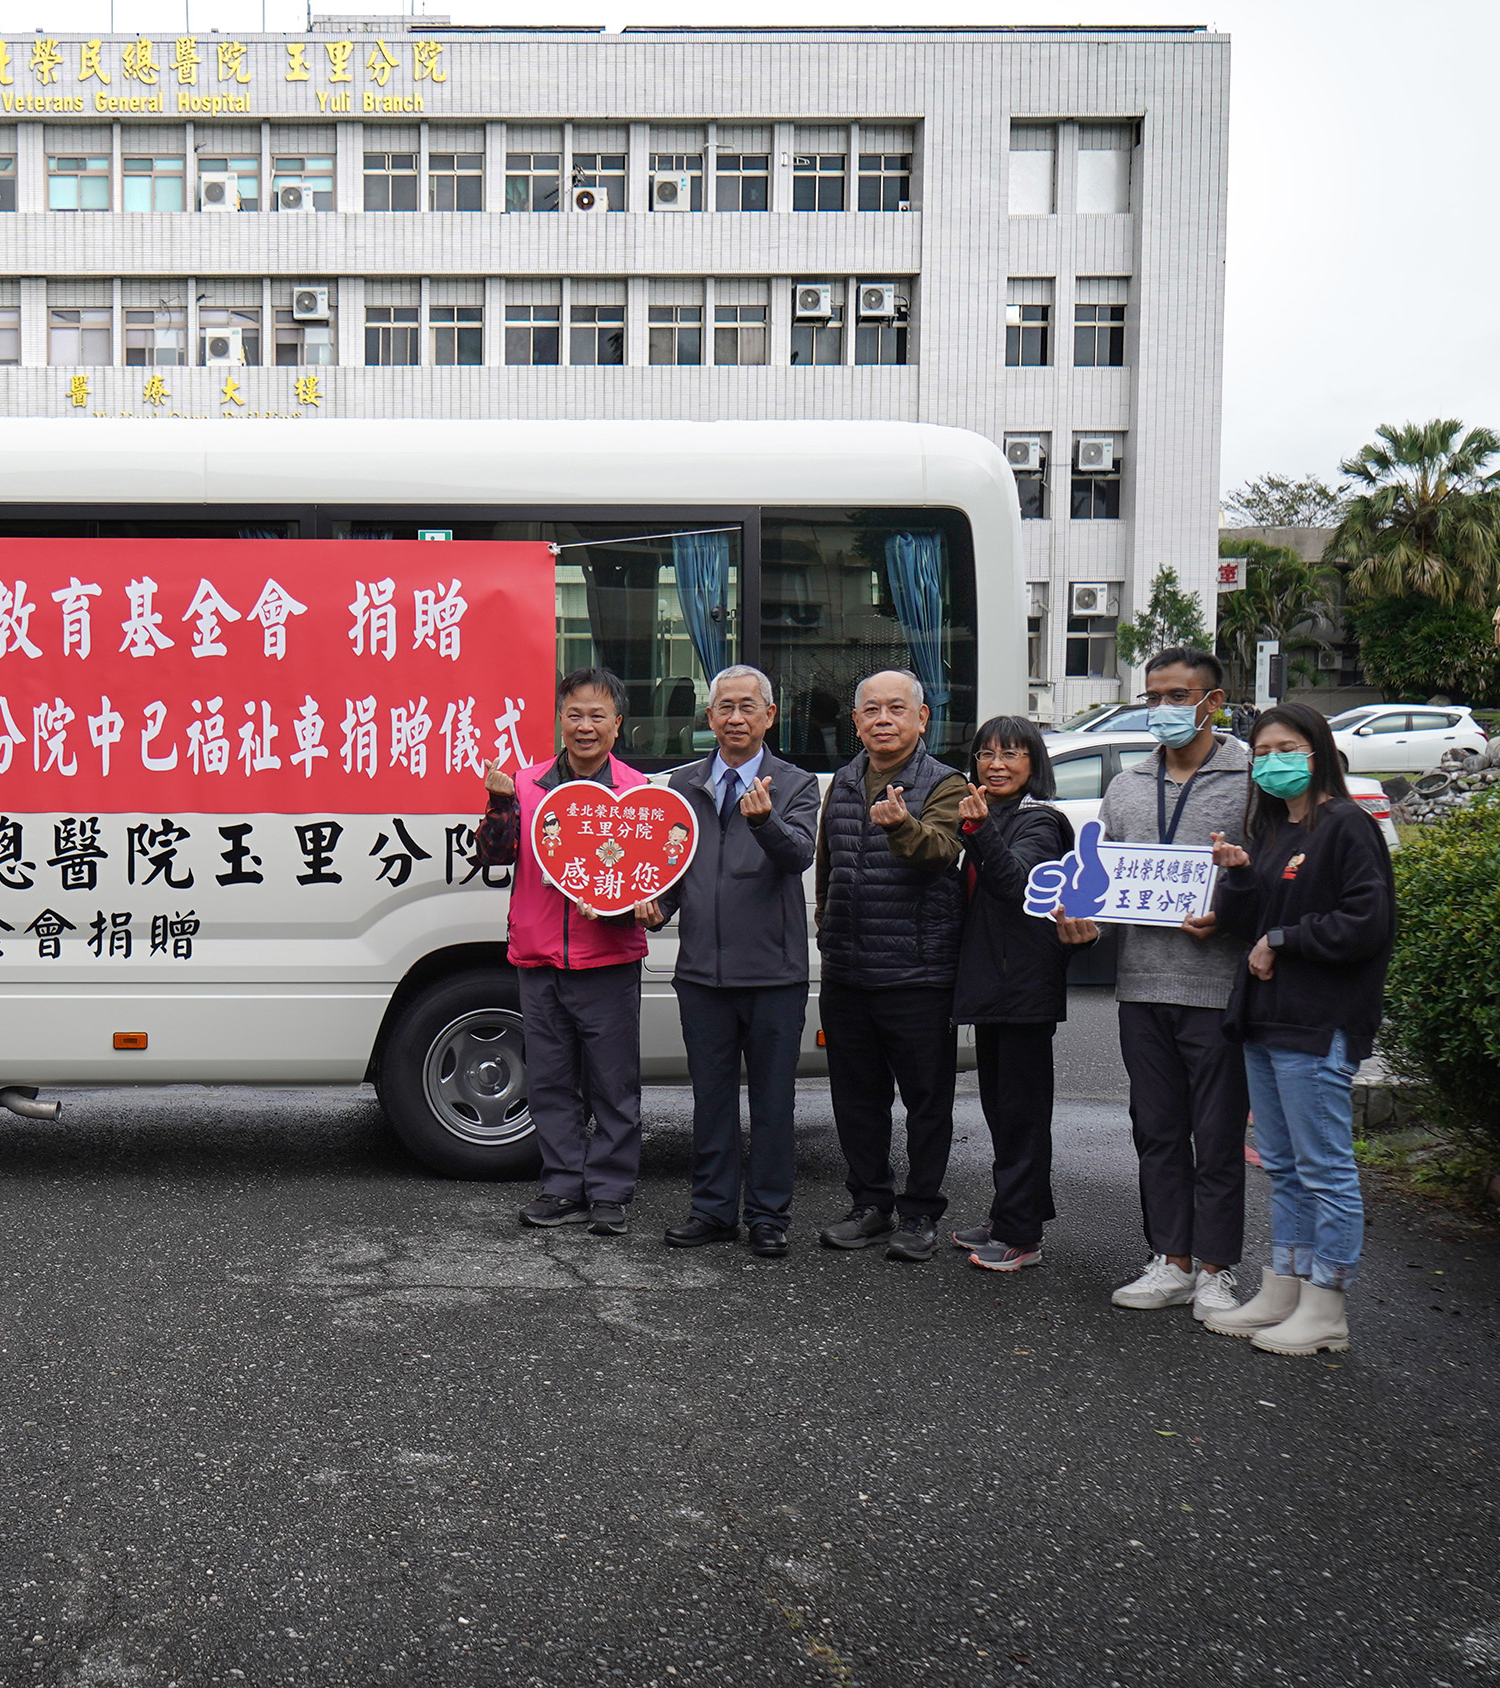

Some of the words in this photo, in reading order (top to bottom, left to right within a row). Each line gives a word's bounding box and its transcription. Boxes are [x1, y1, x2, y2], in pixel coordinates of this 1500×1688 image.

[284, 38, 448, 87] 玉里分院
[2, 92, 84, 112] Veterans
[94, 92, 164, 113] General
[178, 92, 251, 117] Hospital
[317, 92, 350, 112] Yuli
[363, 92, 424, 113] Branch
[65, 374, 323, 408] 醫療大樓
[347, 576, 469, 662] 捐贈
[566, 802, 665, 821] 臺北榮民總醫院
[577, 820, 653, 840] 玉里分院
[560, 856, 661, 900] 感謝您
[1113, 856, 1208, 884] 臺北榮民總醫院
[1115, 889, 1197, 914] 玉里分院
